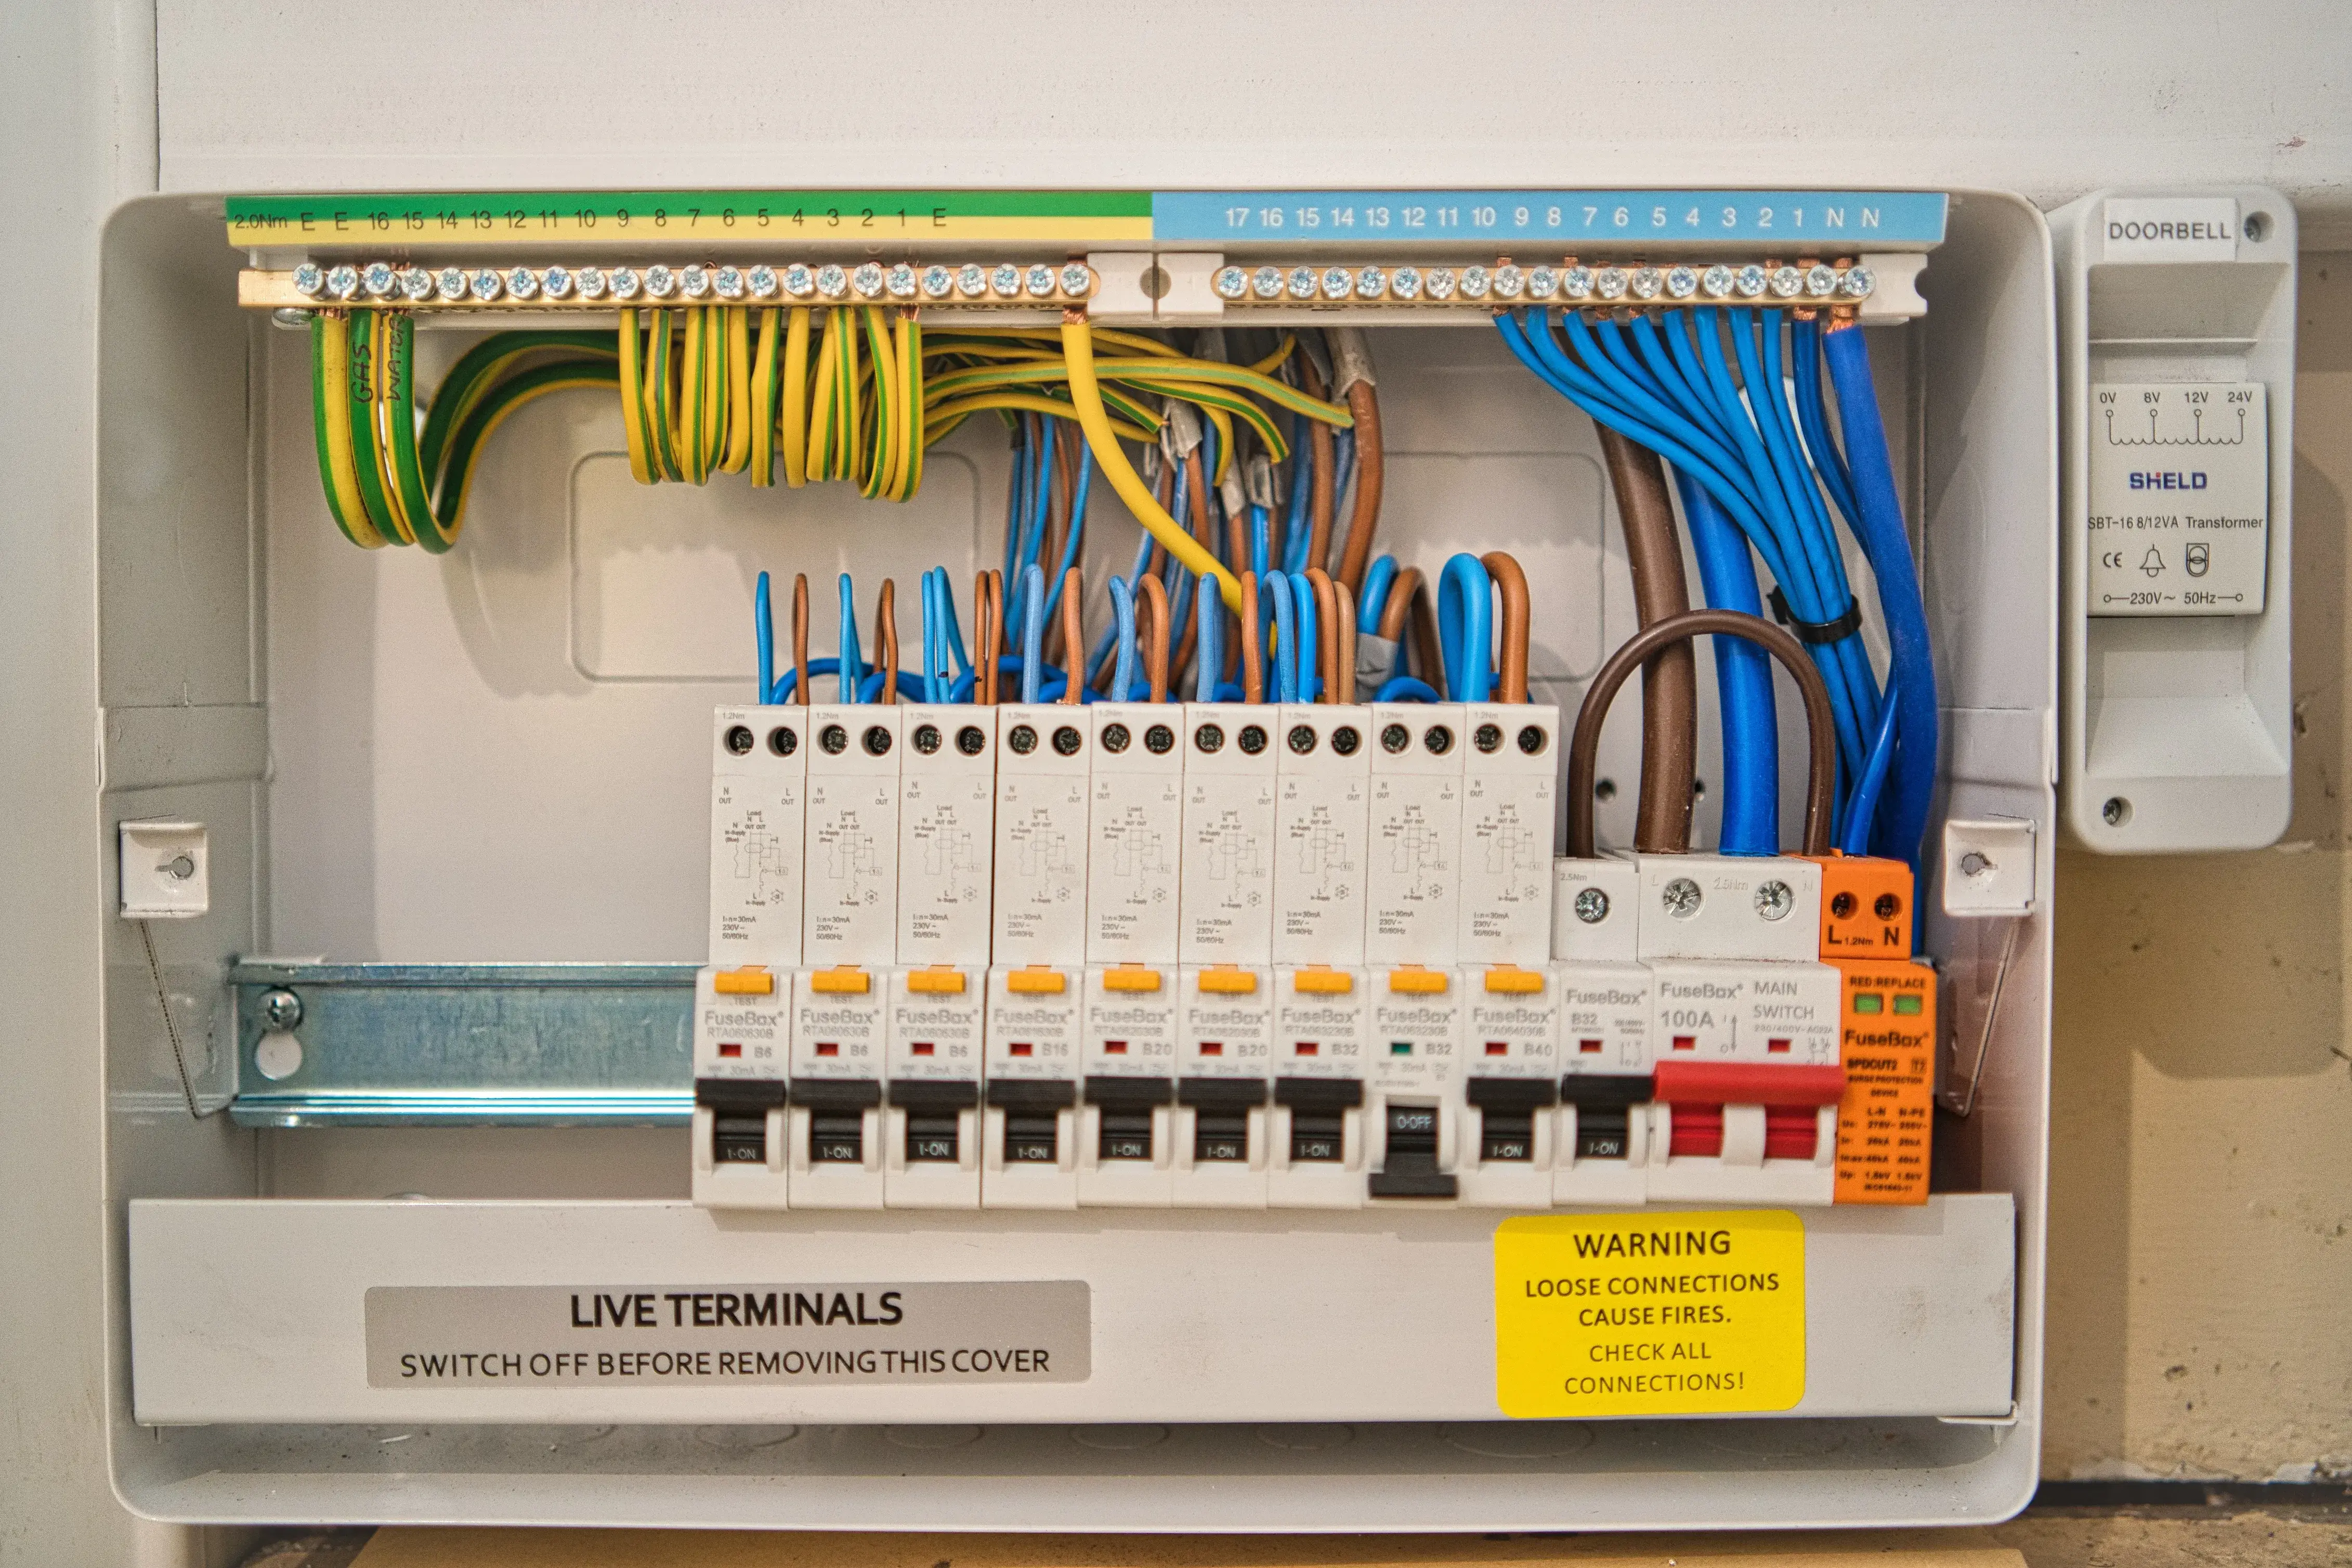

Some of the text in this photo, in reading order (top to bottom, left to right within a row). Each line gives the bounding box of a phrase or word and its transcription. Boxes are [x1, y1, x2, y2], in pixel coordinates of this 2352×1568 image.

[235, 208, 946, 231] 2.0Nm E E 16 15 14 13 12 11 10 9 8 7 6 5 4 3 2 1 E
[1226, 207, 1880, 227] 17 16 15 14 13 12 11 10 9 8 7 6 5 4 3 2 1 N N
[2109, 222, 2231, 240] DOORBELL
[351, 342, 373, 403] GAS
[2100, 391, 2253, 403] 0V 8V 12V 24V
[2186, 516, 2264, 529] Transformer
[2185, 592, 2216, 604] 50Hz
[1828, 925, 1900, 946] L 1.2Nm N
[1754, 982, 1798, 996] MAIN
[1661, 1010, 1714, 1029] 100A
[1754, 1005, 1814, 1019] SWITCH
[1143, 1042, 1172, 1055] B20
[1237, 1044, 1268, 1056] B20
[1331, 1043, 1359, 1056] B32
[1425, 1043, 1453, 1055] B32
[1524, 1043, 1553, 1056] B40
[1573, 1230, 1731, 1259] WARNING
[1526, 1273, 1780, 1298] LOOSE CONNECTIONS
[571, 1292, 903, 1328] LIVE TERMINALS
[1579, 1305, 1731, 1326] CAUSE FIRES.
[1590, 1342, 1711, 1362] CHECK ALL
[401, 1350, 1050, 1377] SWITCH OFF BEFORE REMOVING THIS COVER
[1565, 1373, 1744, 1395] CONNECTIONS!
